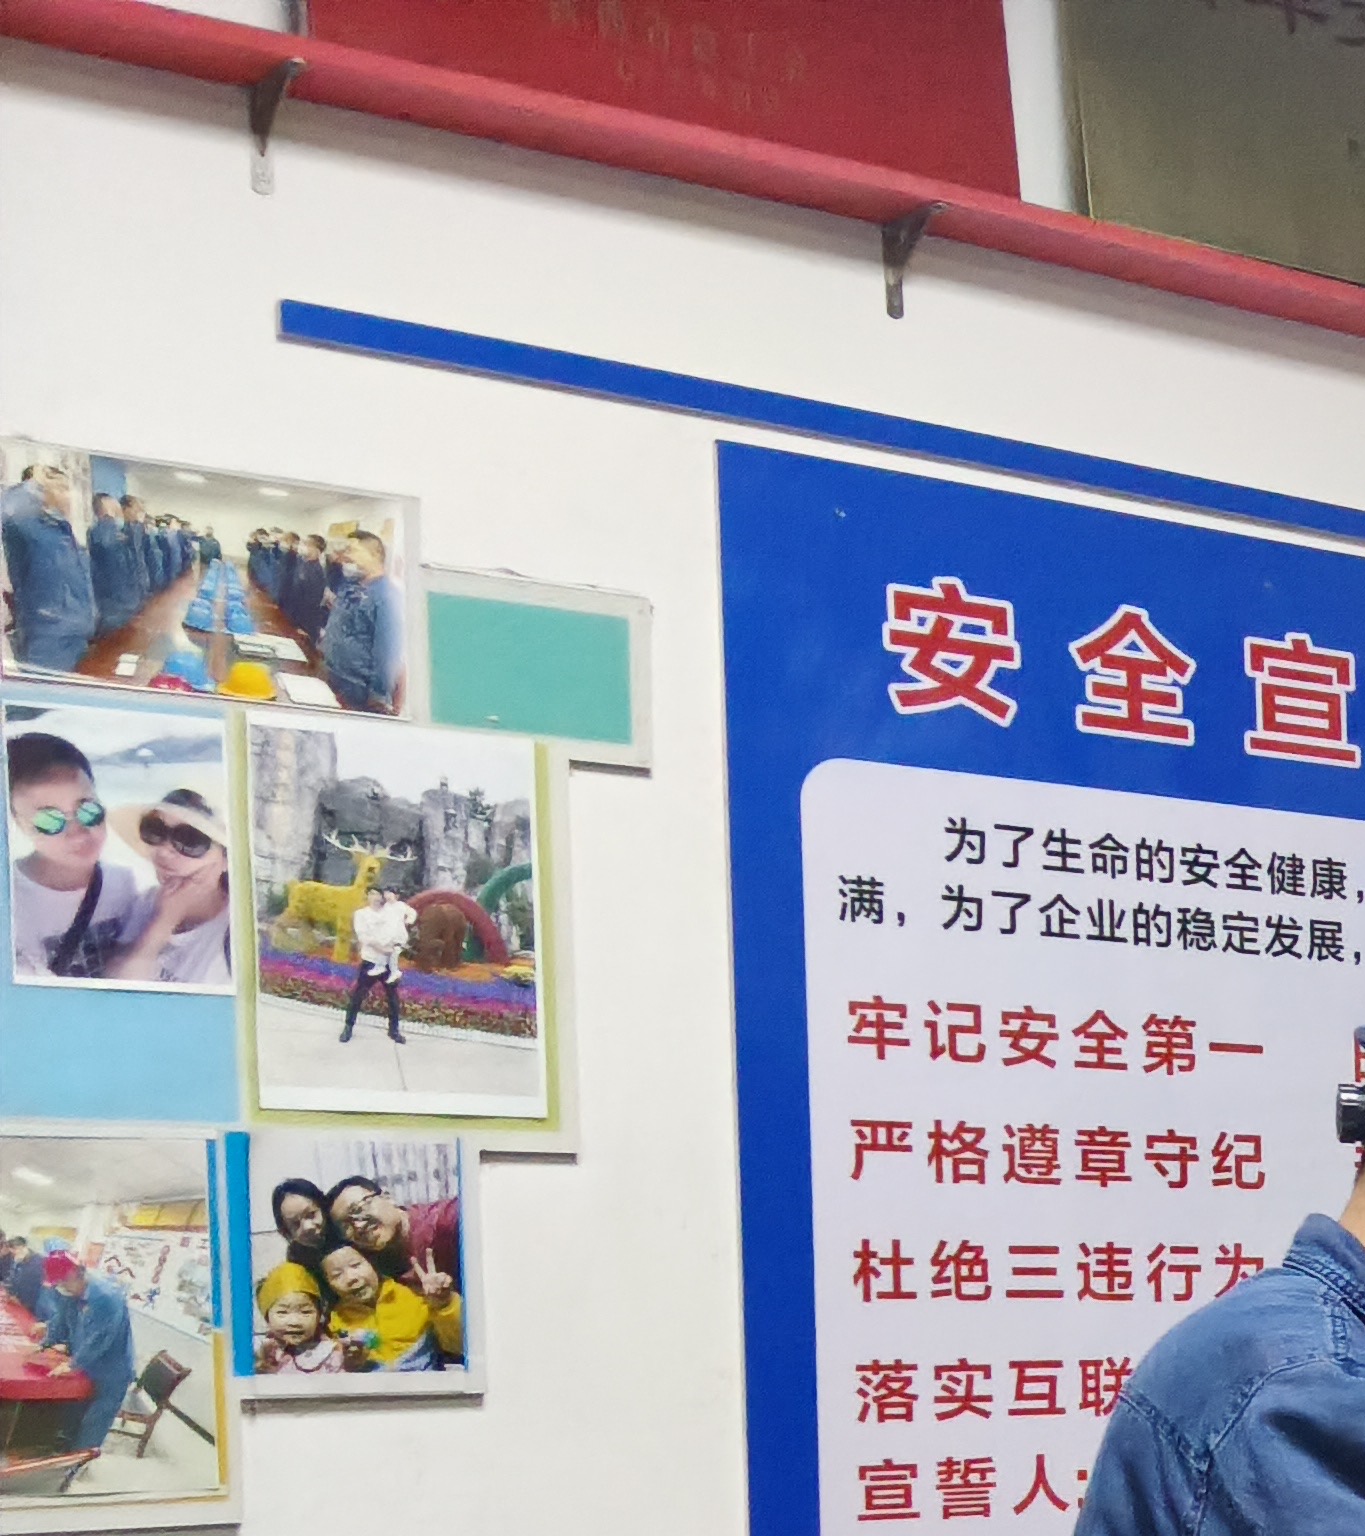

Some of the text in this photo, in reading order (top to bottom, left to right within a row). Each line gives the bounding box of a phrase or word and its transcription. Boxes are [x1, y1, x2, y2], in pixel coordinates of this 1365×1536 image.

[847, 995, 1265, 1077] 牢记安全第一
[850, 1118, 1267, 1190] 严格遵章守纪
[853, 1239, 1264, 1303] 杜绝三违行为
[855, 1356, 1132, 1423] 落实互联
